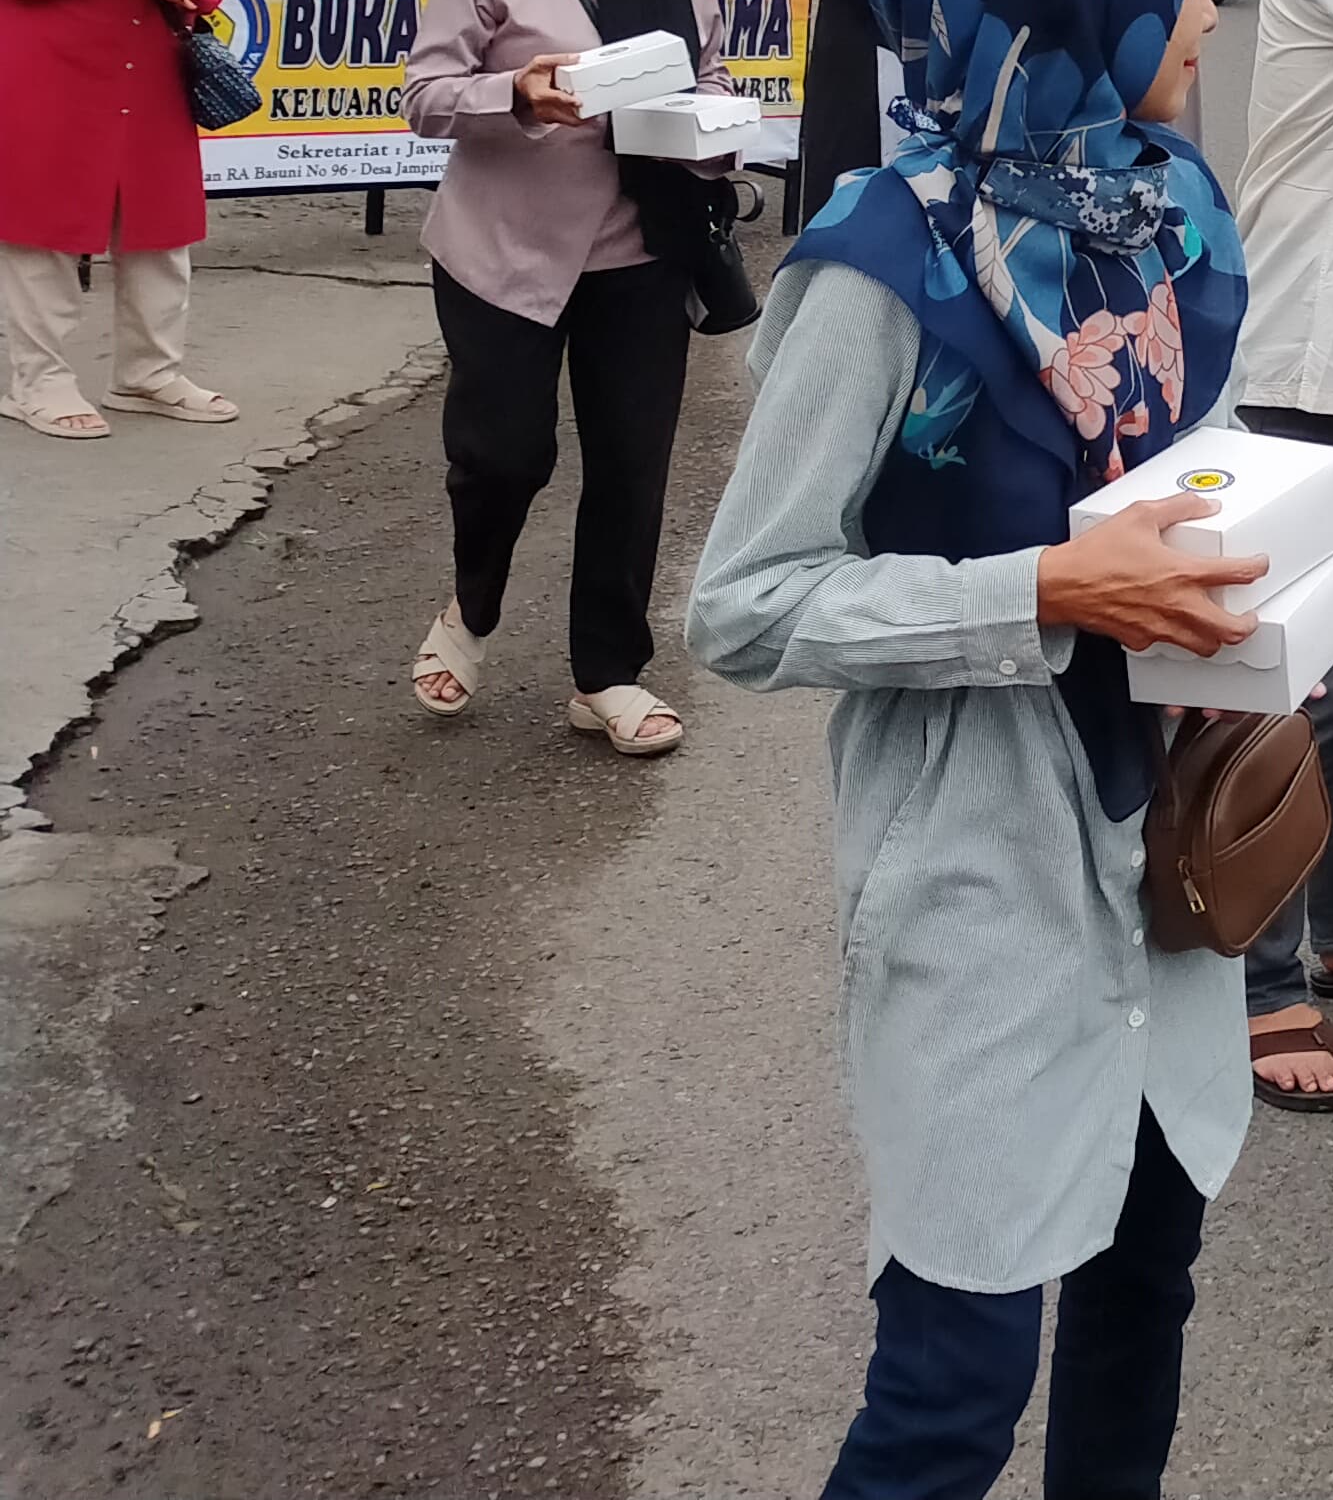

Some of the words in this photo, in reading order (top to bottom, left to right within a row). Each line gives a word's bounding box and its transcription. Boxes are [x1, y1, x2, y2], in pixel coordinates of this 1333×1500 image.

[278, 143, 389, 160] Sekretariat
[405, 141, 451, 158] Jawa
[227, 168, 250, 181] RA
[254, 164, 302, 180] Basuni
[306, 164, 328, 178] No
[331, 164, 348, 177] 96
[361, 162, 392, 175] Desa
